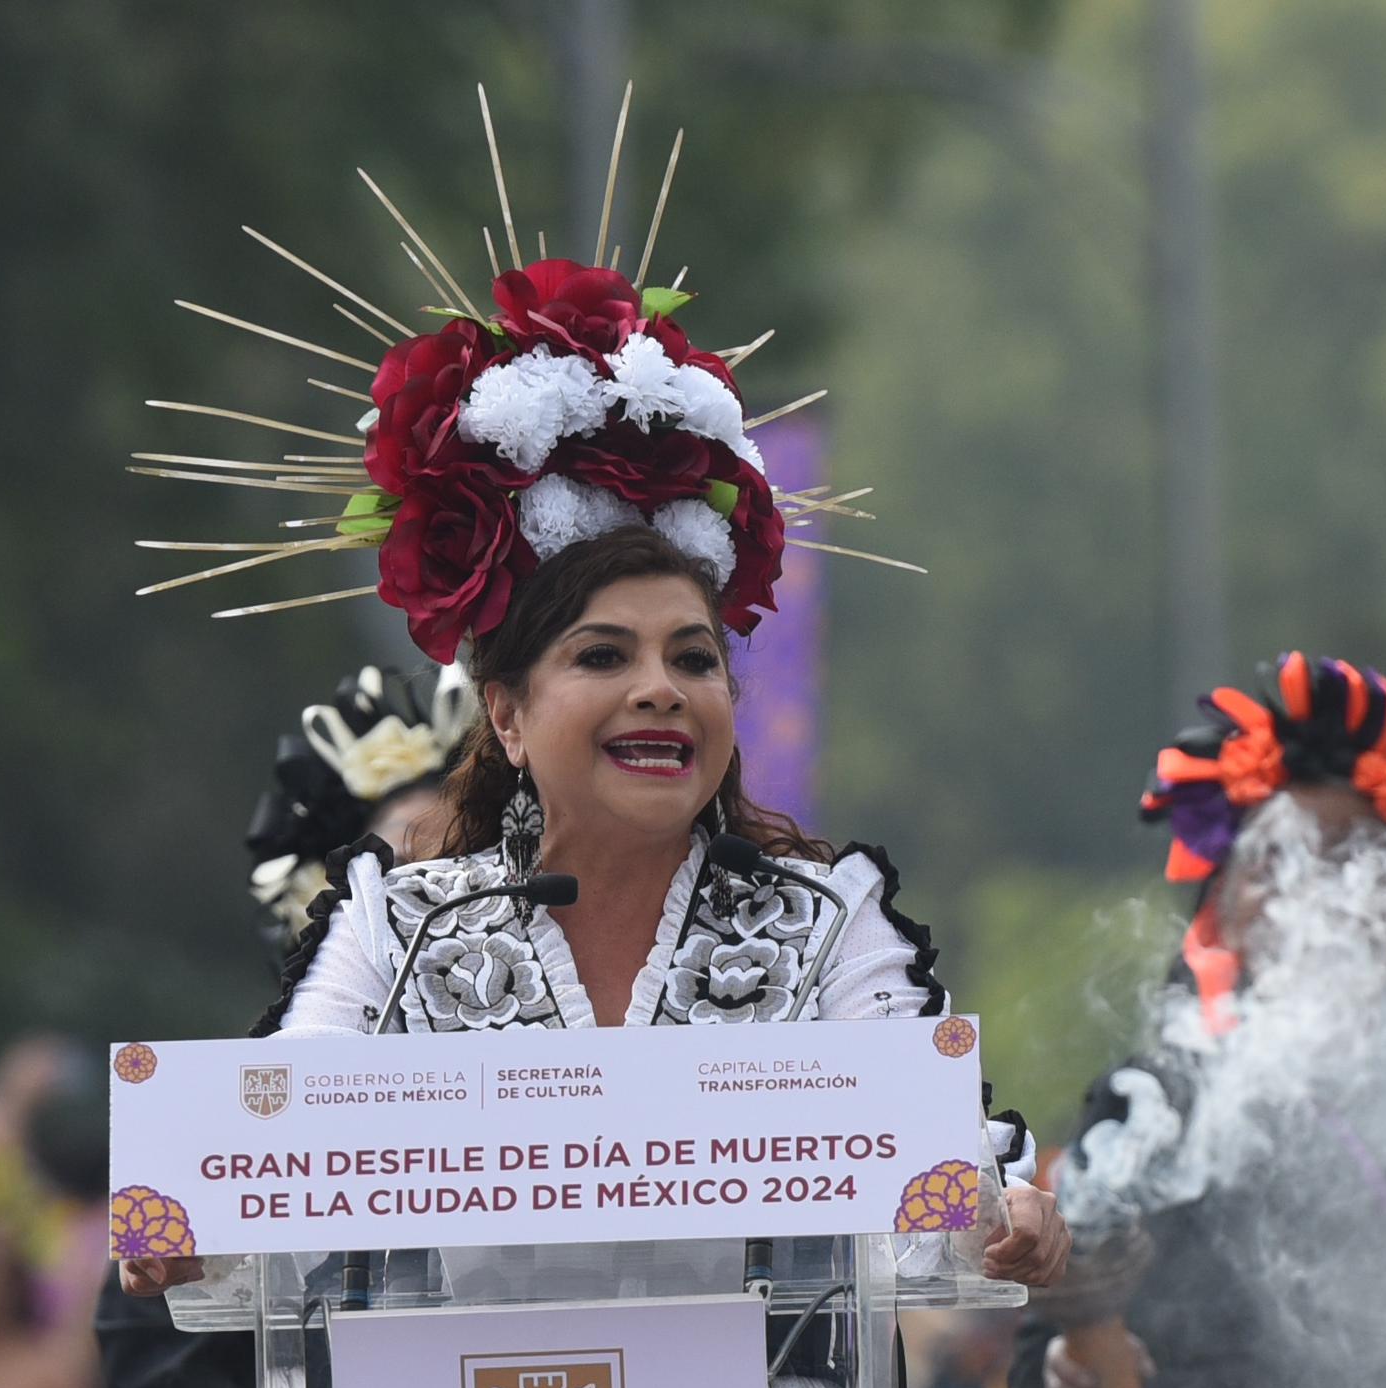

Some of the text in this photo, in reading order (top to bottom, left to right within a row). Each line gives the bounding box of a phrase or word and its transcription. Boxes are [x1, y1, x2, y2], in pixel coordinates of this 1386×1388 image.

[498, 1064, 602, 1081] SECRETARÍA
[698, 1060, 821, 1074] CAPITAL DE LA
[305, 1072, 465, 1087] GOBIERNO DE LA
[699, 1074, 856, 1092] TRANSFORMACIÓN
[305, 1087, 467, 1105] CIUDAD DE MÉXICO
[498, 1085, 603, 1099] DE CULTURA
[200, 1133, 897, 1181] GRAN DESFILE DE DÍA DE MUERTOS
[240, 1173, 858, 1220] DE LA CIUDAD DE MÉXICO 2024
